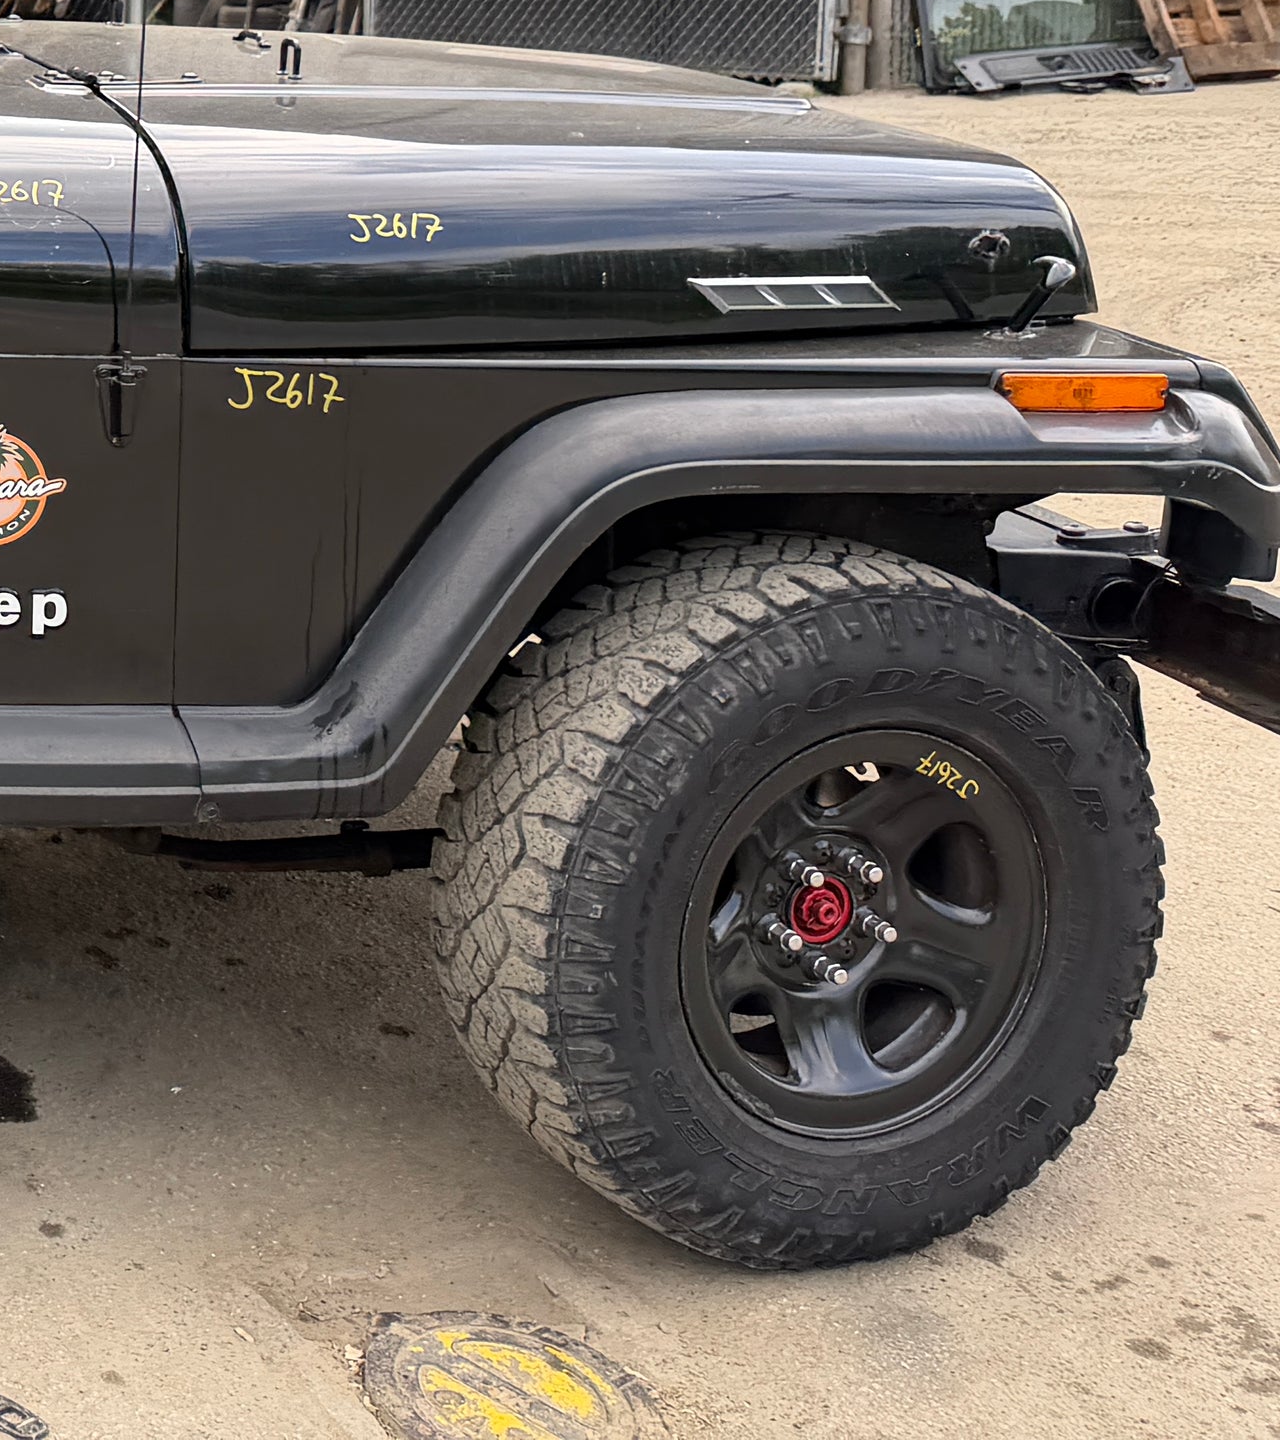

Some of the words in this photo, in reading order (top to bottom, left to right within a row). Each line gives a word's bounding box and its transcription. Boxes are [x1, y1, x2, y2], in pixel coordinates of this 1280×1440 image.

[348, 212, 444, 243] J2617
[227, 366, 345, 414] J2617
[916, 751, 980, 799] J2617
